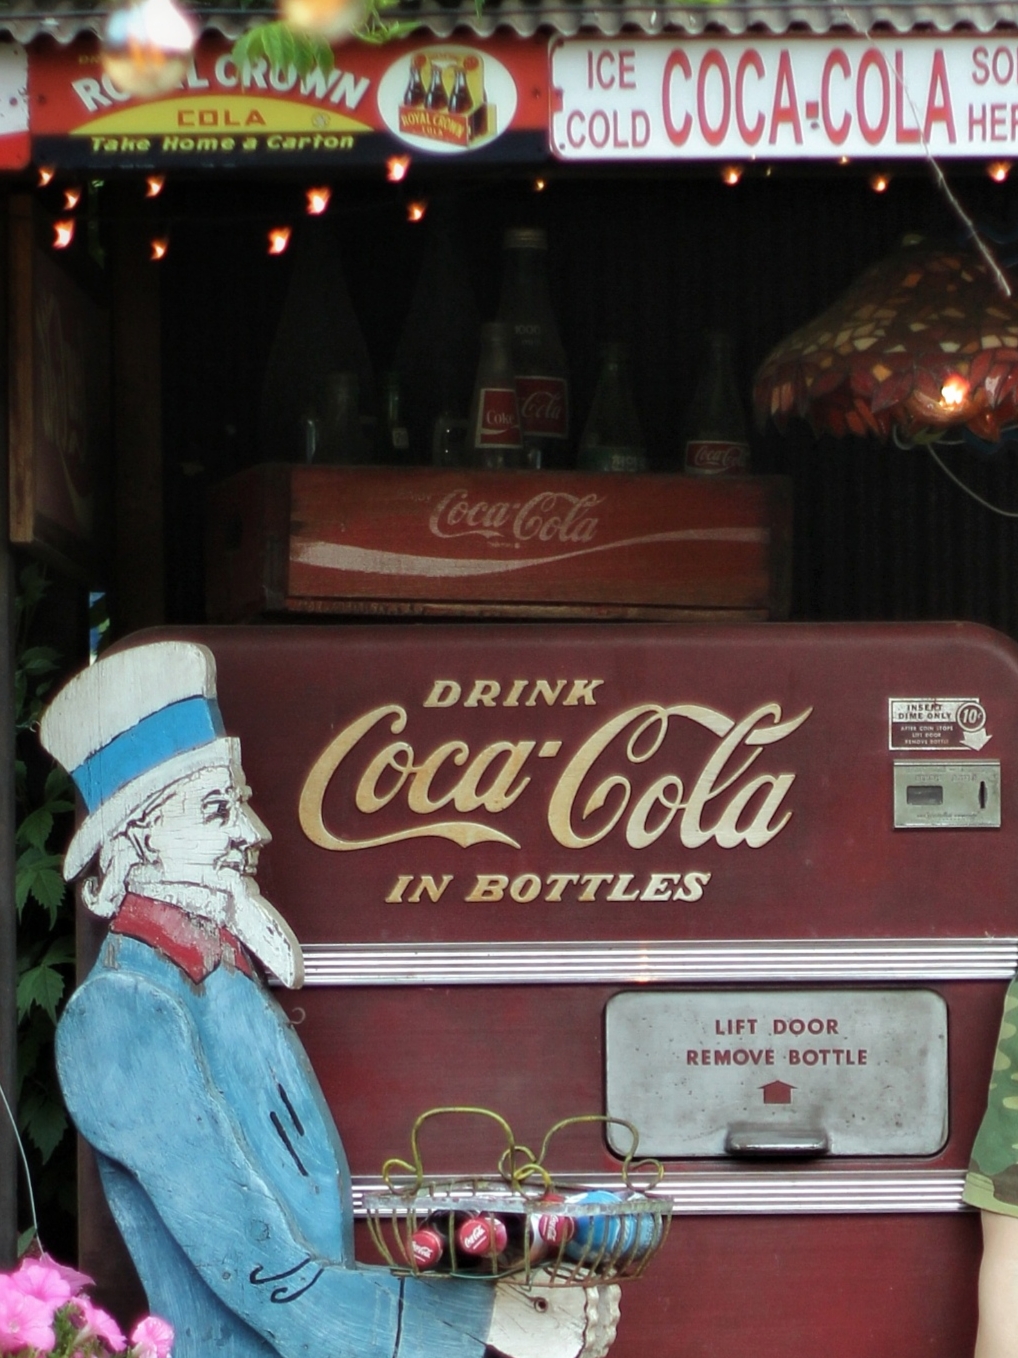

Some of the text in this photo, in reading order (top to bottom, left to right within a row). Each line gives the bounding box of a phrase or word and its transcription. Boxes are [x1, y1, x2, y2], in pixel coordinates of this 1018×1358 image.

[587, 50, 637, 90] ICE
[662, 48, 957, 146] COCA-COLA
[177, 109, 266, 127] COLA
[401, 112, 431, 127] ROYAL
[566, 108, 651, 148] COLD
[91, 134, 355, 152] Take Home a Carton
[486, 410, 515, 425] Coke
[429, 489, 608, 543] Coca-Cola
[424, 679, 604, 708] DRINK
[898, 712, 952, 720] DIME ONLY
[907, 704, 942, 712] INSERT
[298, 703, 814, 852] Coca-Cola
[385, 872, 712, 903] IN BOTTLES
[714, 1019, 840, 1035] LIFT DOOR
[686, 1049, 868, 1065] REMOVE BOTTLE
